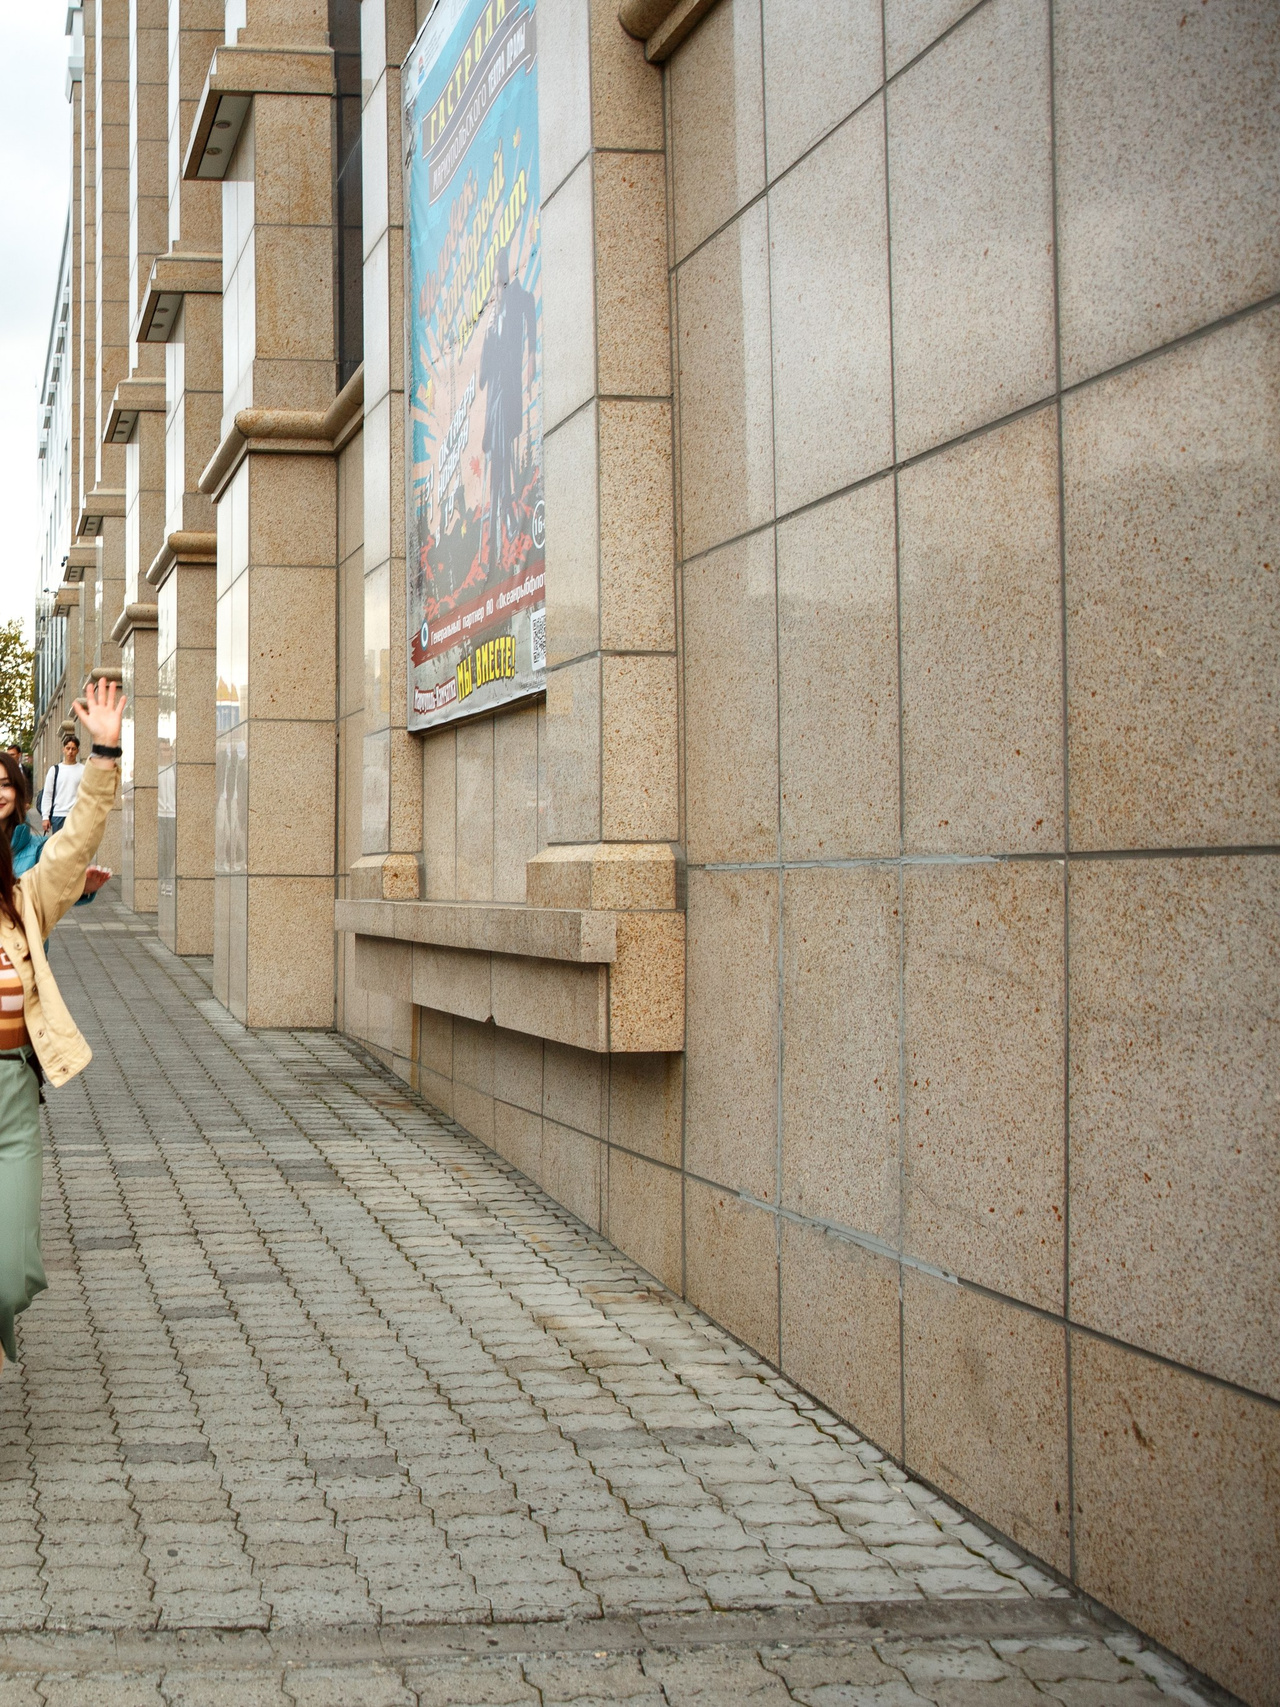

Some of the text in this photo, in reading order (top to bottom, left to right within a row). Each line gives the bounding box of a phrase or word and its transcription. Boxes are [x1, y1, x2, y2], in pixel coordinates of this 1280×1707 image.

[438, 137, 504, 346] который
[438, 372, 475, 472] ОКТЯБРЯ
[438, 417, 468, 504] НОЯБРЯ
[457, 654, 472, 702] МЫ
[476, 636, 516, 688] ВМЕСТЕ!
